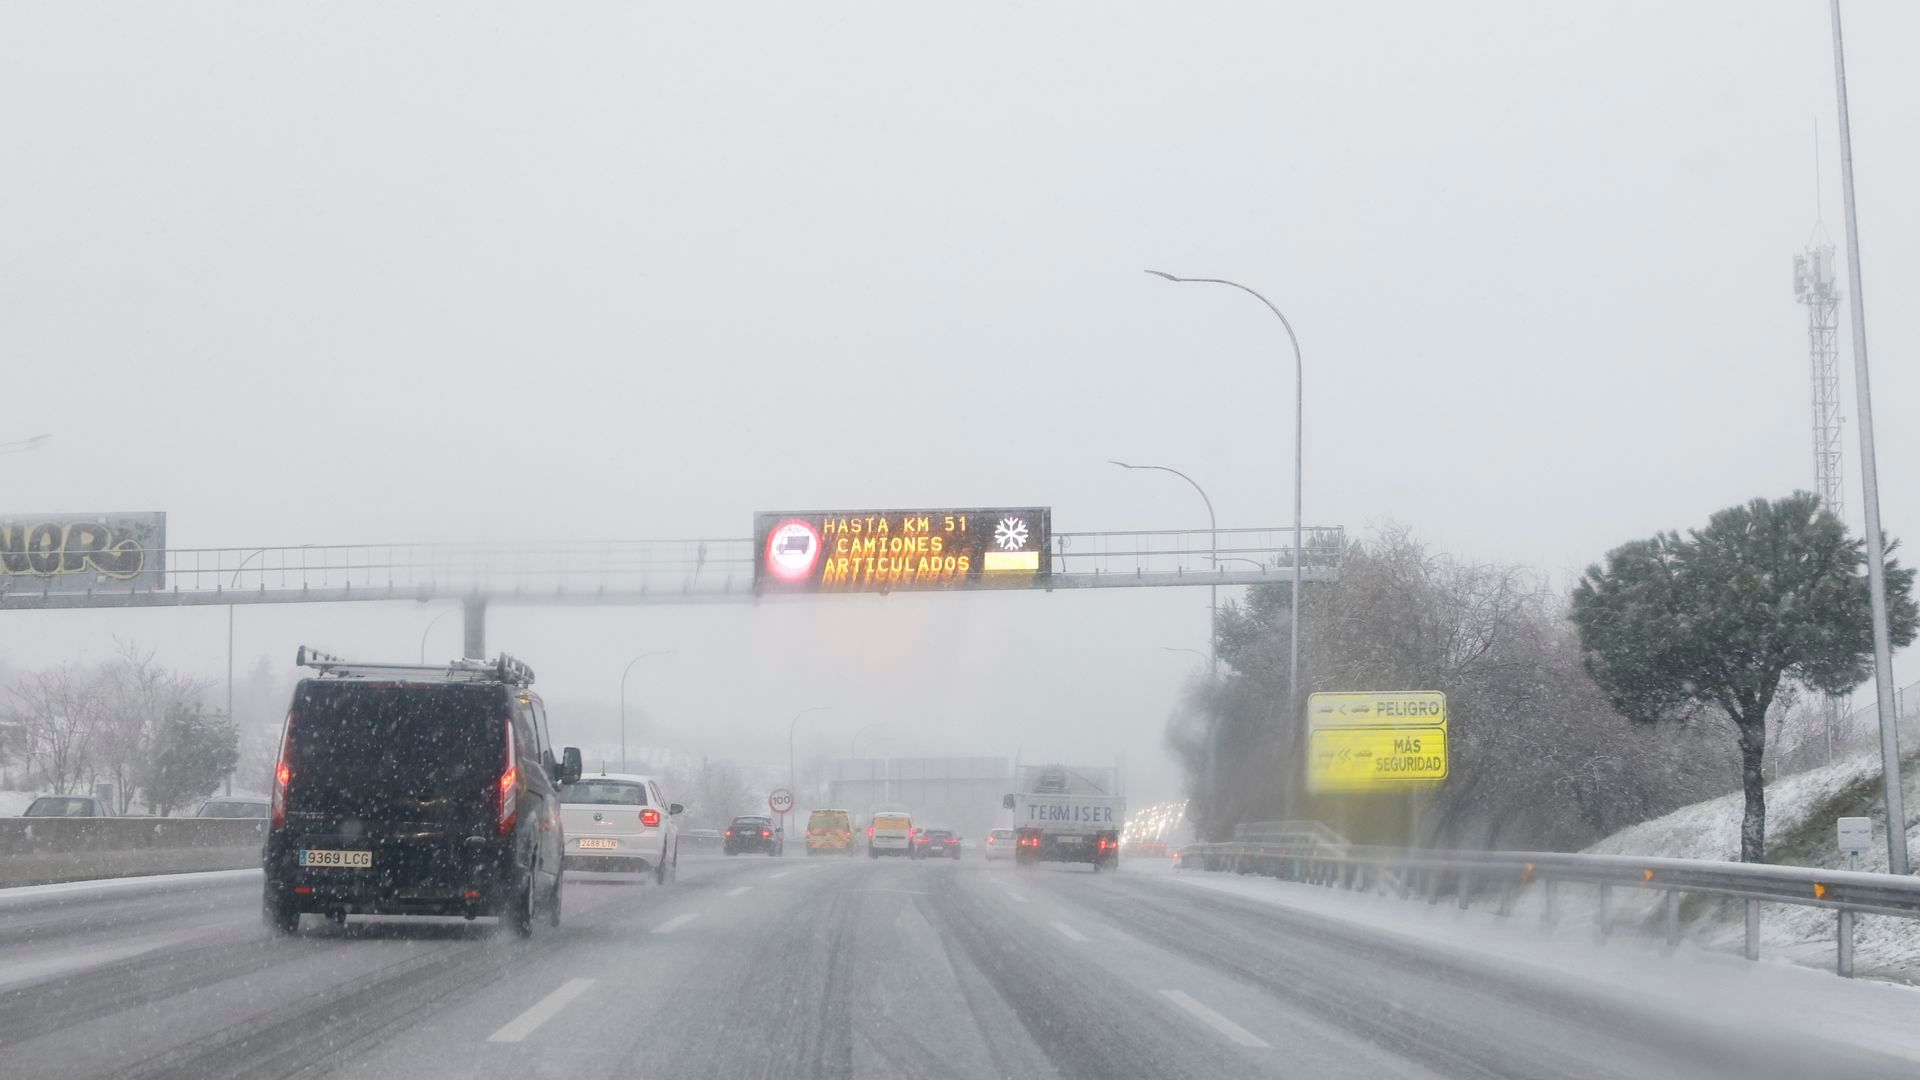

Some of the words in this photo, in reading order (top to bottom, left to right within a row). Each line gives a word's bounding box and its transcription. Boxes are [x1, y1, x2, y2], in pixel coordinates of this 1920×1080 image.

[823, 517, 889, 534] HASTA
[903, 517, 930, 532] KM
[944, 516, 967, 531] 51
[837, 537, 943, 553] CAMIONES
[824, 556, 970, 573] ARTICULADOS
[1375, 701, 1439, 716] PELIGRO
[1393, 736, 1421, 754] MÁS
[1375, 756, 1441, 772] SEGURIDAD
[772, 795, 791, 805] 100
[1027, 804, 1113, 823] TERMISER
[308, 851, 340, 864] 9369
[343, 852, 369, 865] LCG
